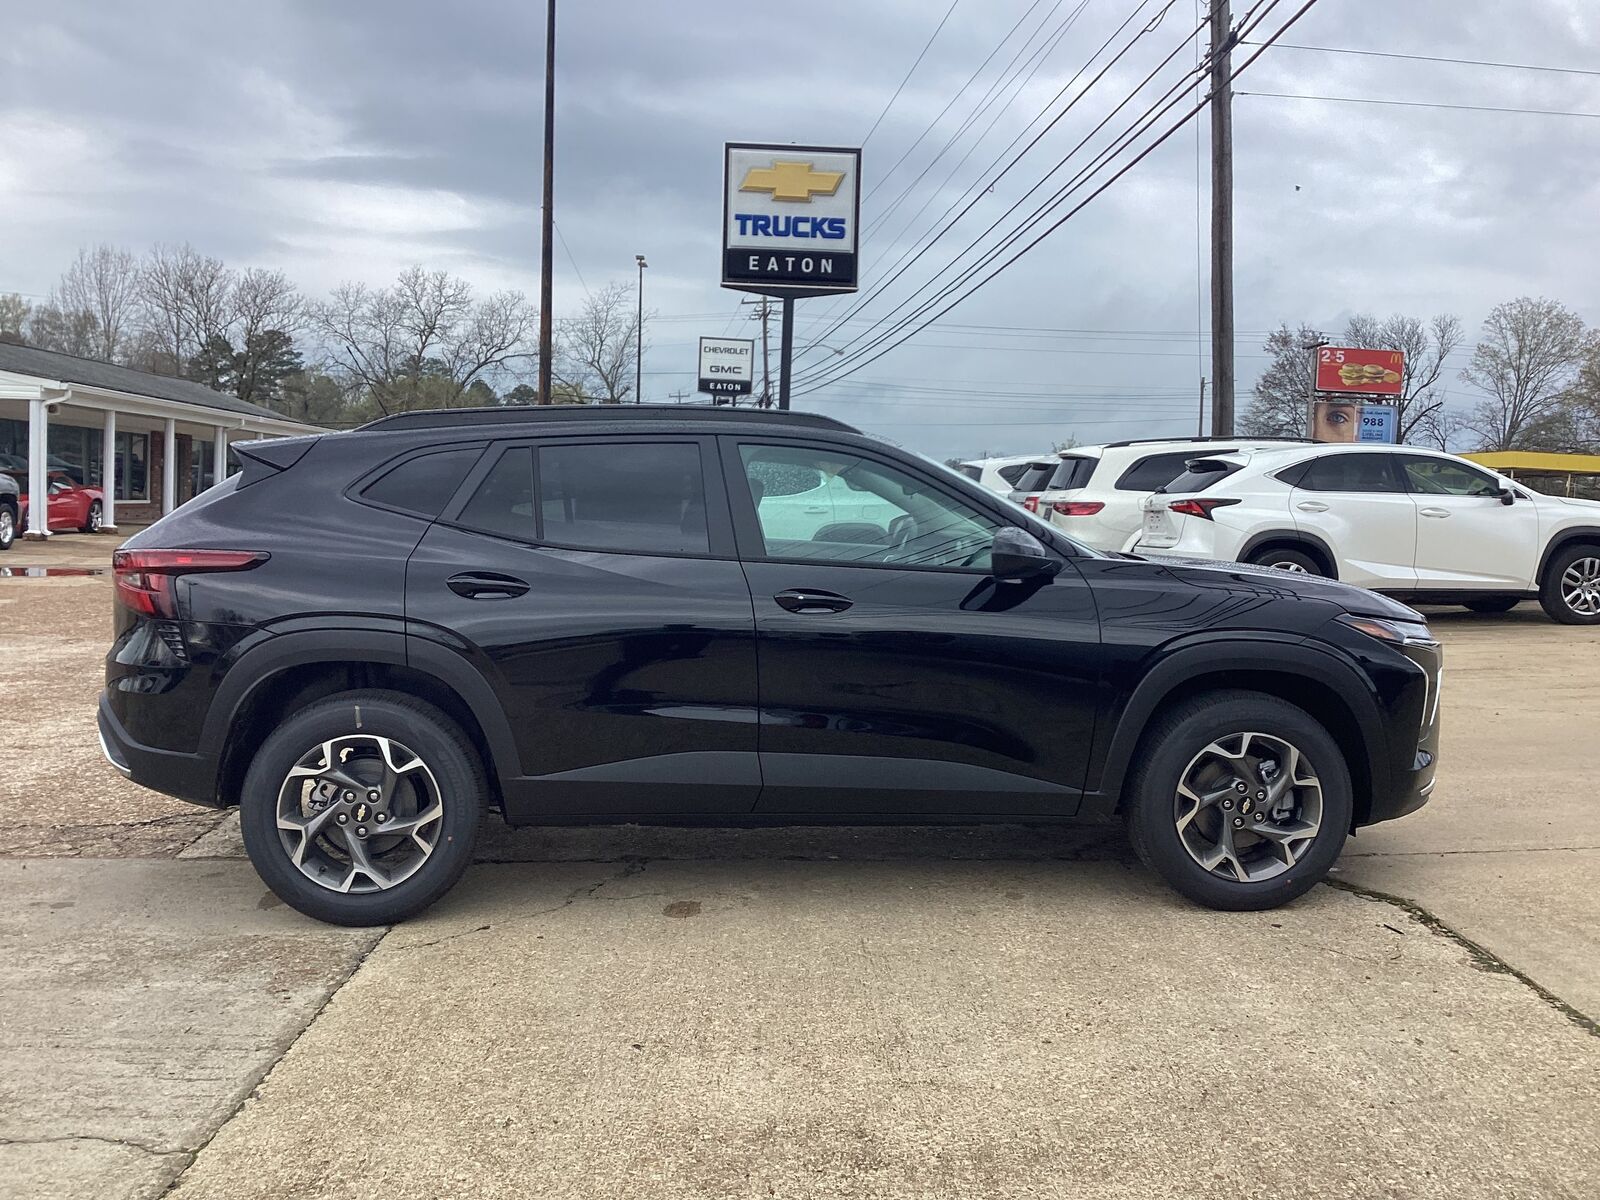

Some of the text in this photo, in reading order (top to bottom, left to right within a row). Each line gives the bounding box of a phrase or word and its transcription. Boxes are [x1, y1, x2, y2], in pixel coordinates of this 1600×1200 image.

[735, 214, 845, 239] TRUCKS
[749, 255, 833, 273] EATON
[703, 345, 750, 355] CHEVROLET
[710, 365, 742, 374] GMC
[709, 382, 742, 391] EATON
[1363, 418, 1383, 426] 988
